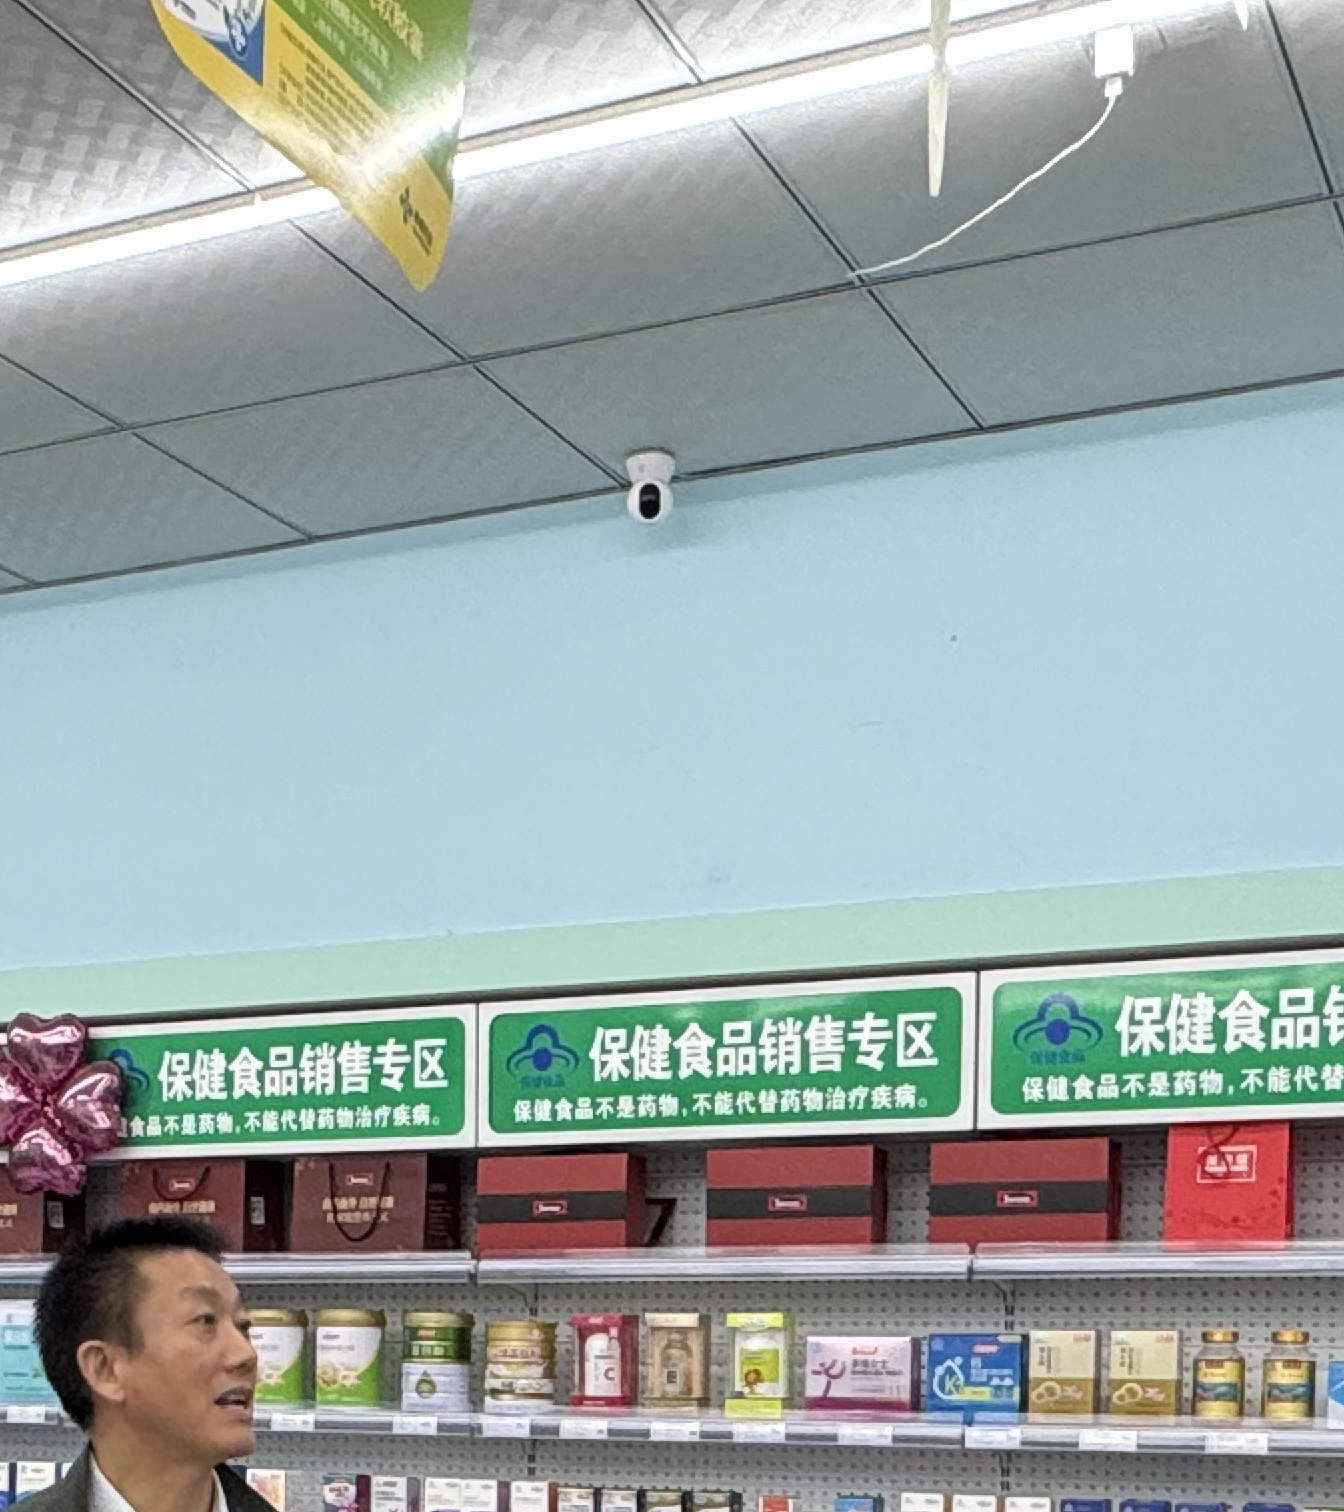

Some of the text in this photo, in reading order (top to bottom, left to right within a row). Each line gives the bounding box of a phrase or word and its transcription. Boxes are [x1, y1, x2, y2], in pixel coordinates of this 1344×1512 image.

[158, 1038, 449, 1102] 保健食品销售专区
[588, 1011, 939, 1082] 保健食品销售专区
